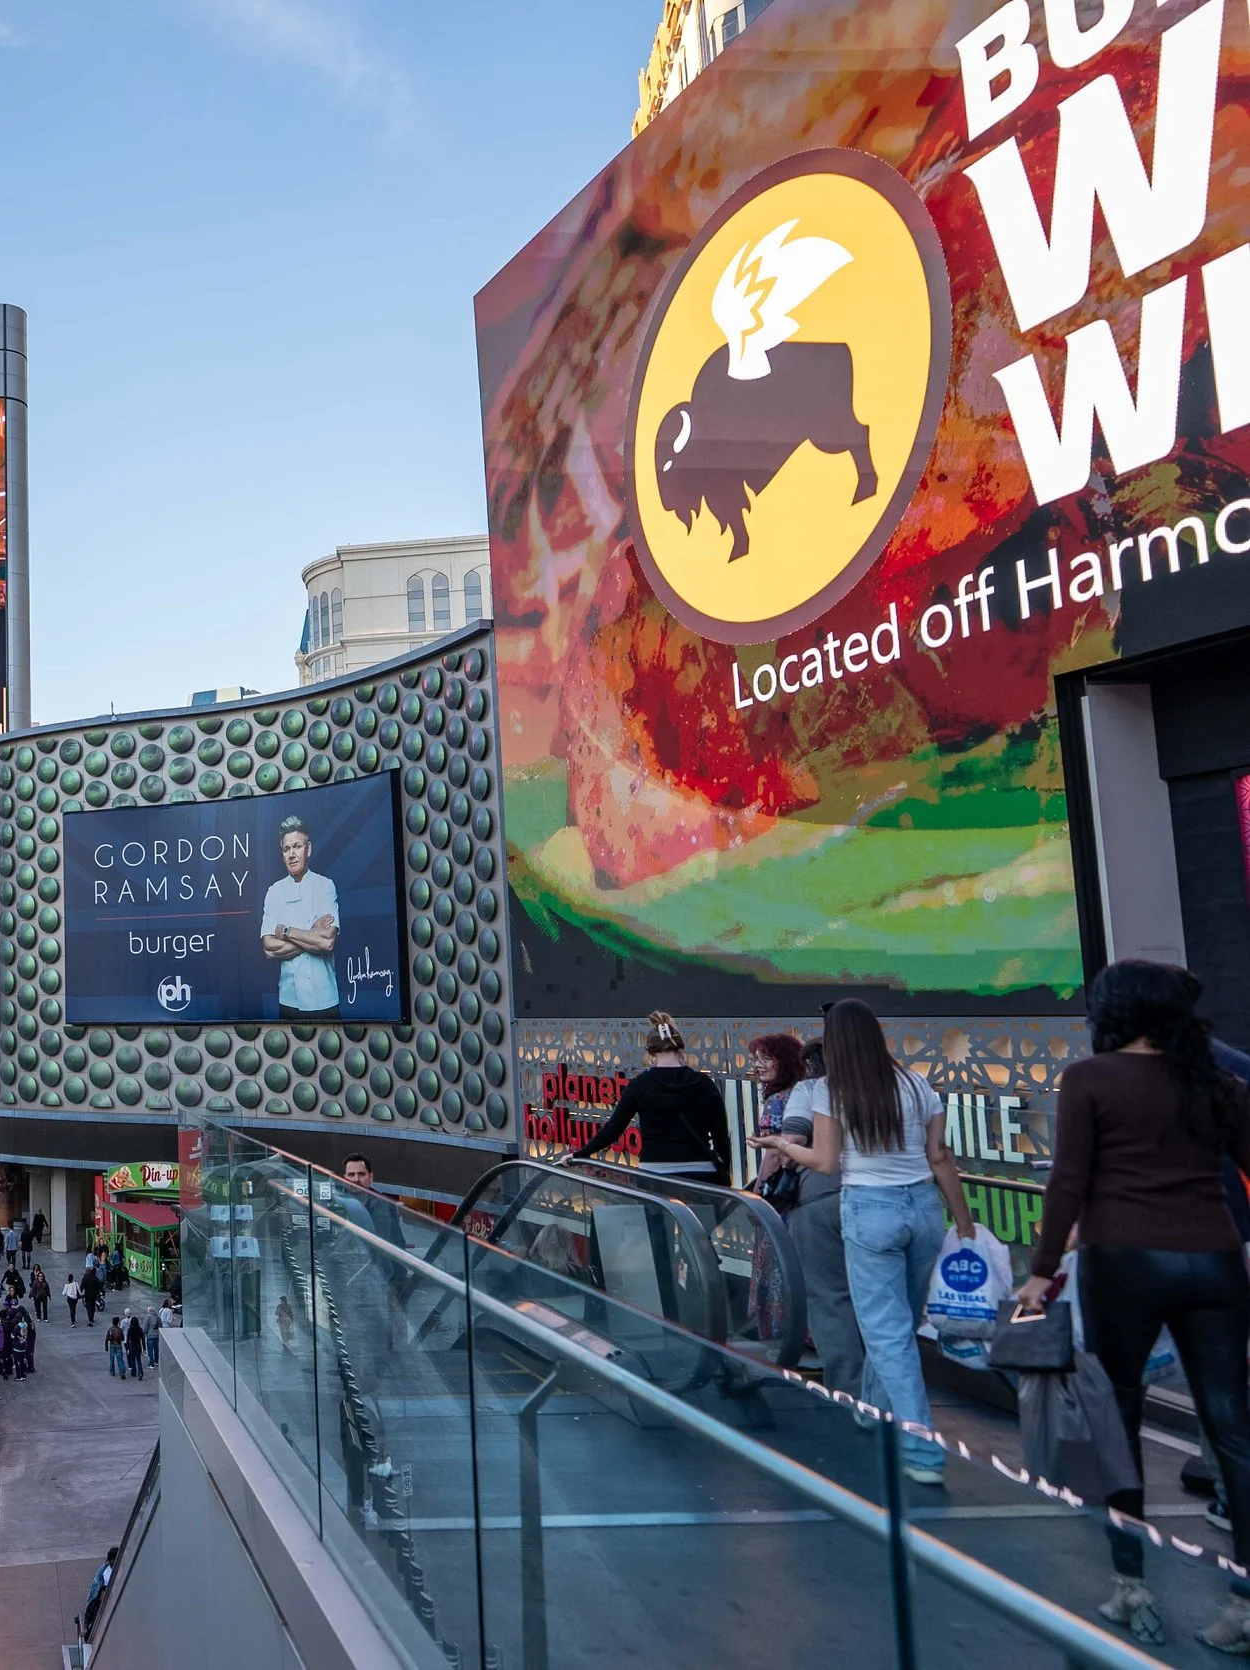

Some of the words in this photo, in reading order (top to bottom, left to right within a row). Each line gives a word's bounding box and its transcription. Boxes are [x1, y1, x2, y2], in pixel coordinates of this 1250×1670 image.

[732, 603, 901, 710] Located
[919, 565, 996, 649] off
[1015, 498, 1250, 620] Harmo
[94, 832, 250, 869] GORDON
[94, 871, 249, 904] RAMSAY
[128, 931, 215, 959] burger
[542, 1062, 630, 1110] planet
[140, 1165, 179, 1187] Pin-up
[947, 1259, 982, 1273] ABC
[938, 1289, 956, 1299] LAS
[958, 1291, 987, 1302] VEGAS
